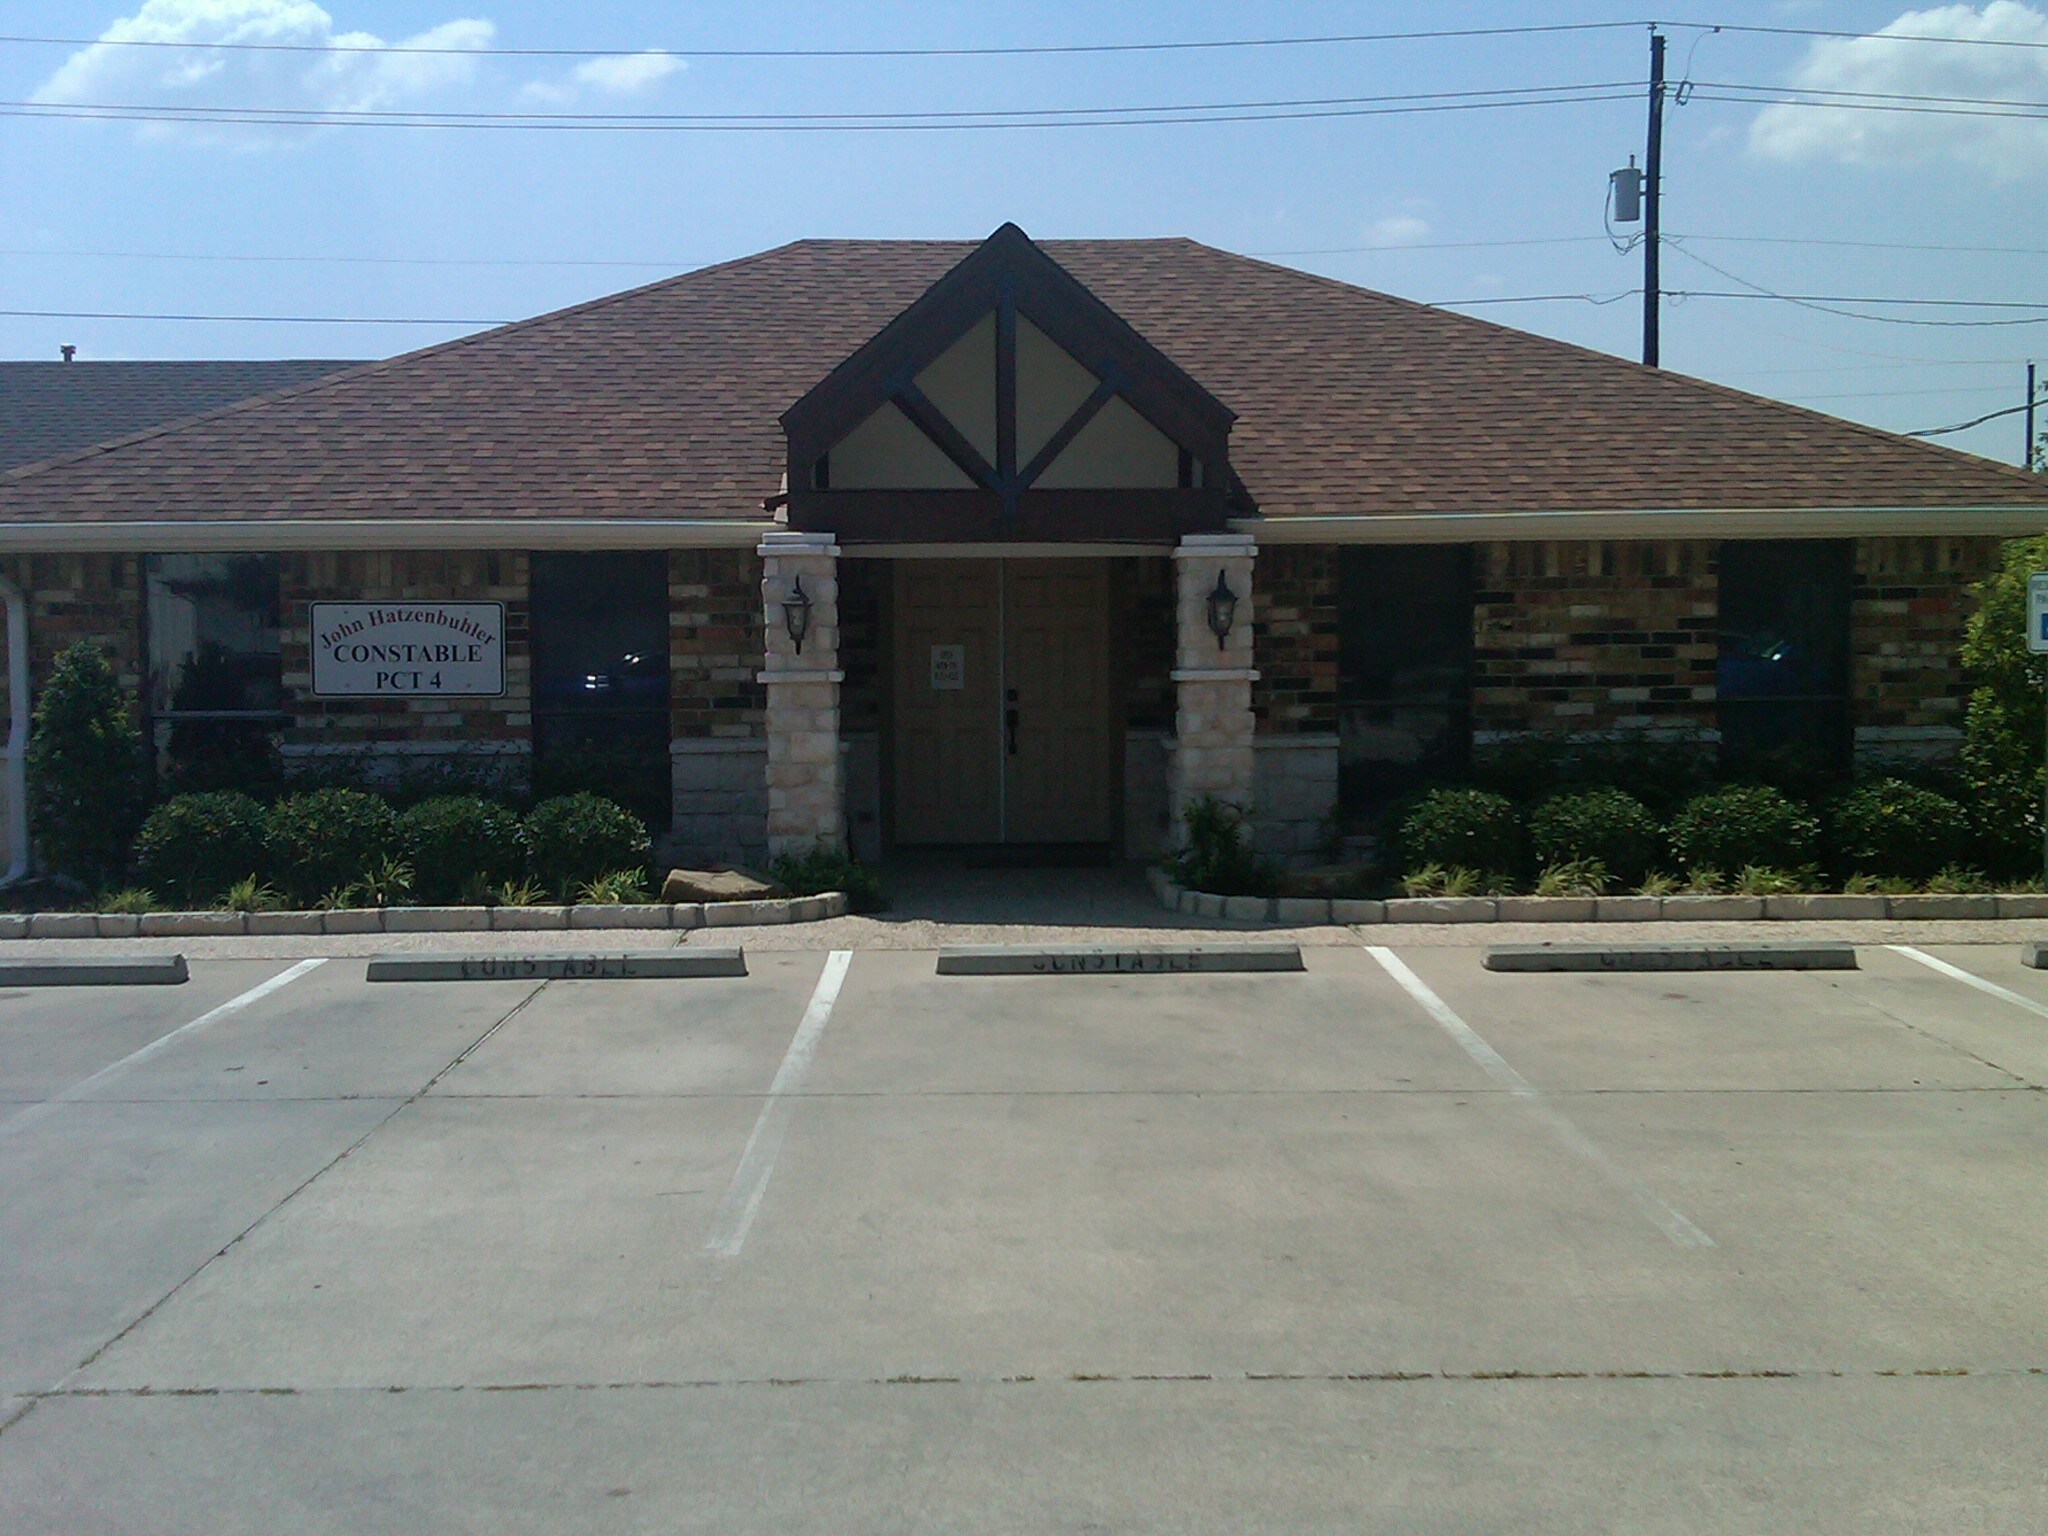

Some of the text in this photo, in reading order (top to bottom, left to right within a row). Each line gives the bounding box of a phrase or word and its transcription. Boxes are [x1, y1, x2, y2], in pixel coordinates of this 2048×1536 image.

[320, 608, 497, 649] John Hatzenbuhler
[334, 644, 483, 664] CONSTABLE
[376, 671, 442, 690] PCT 4
